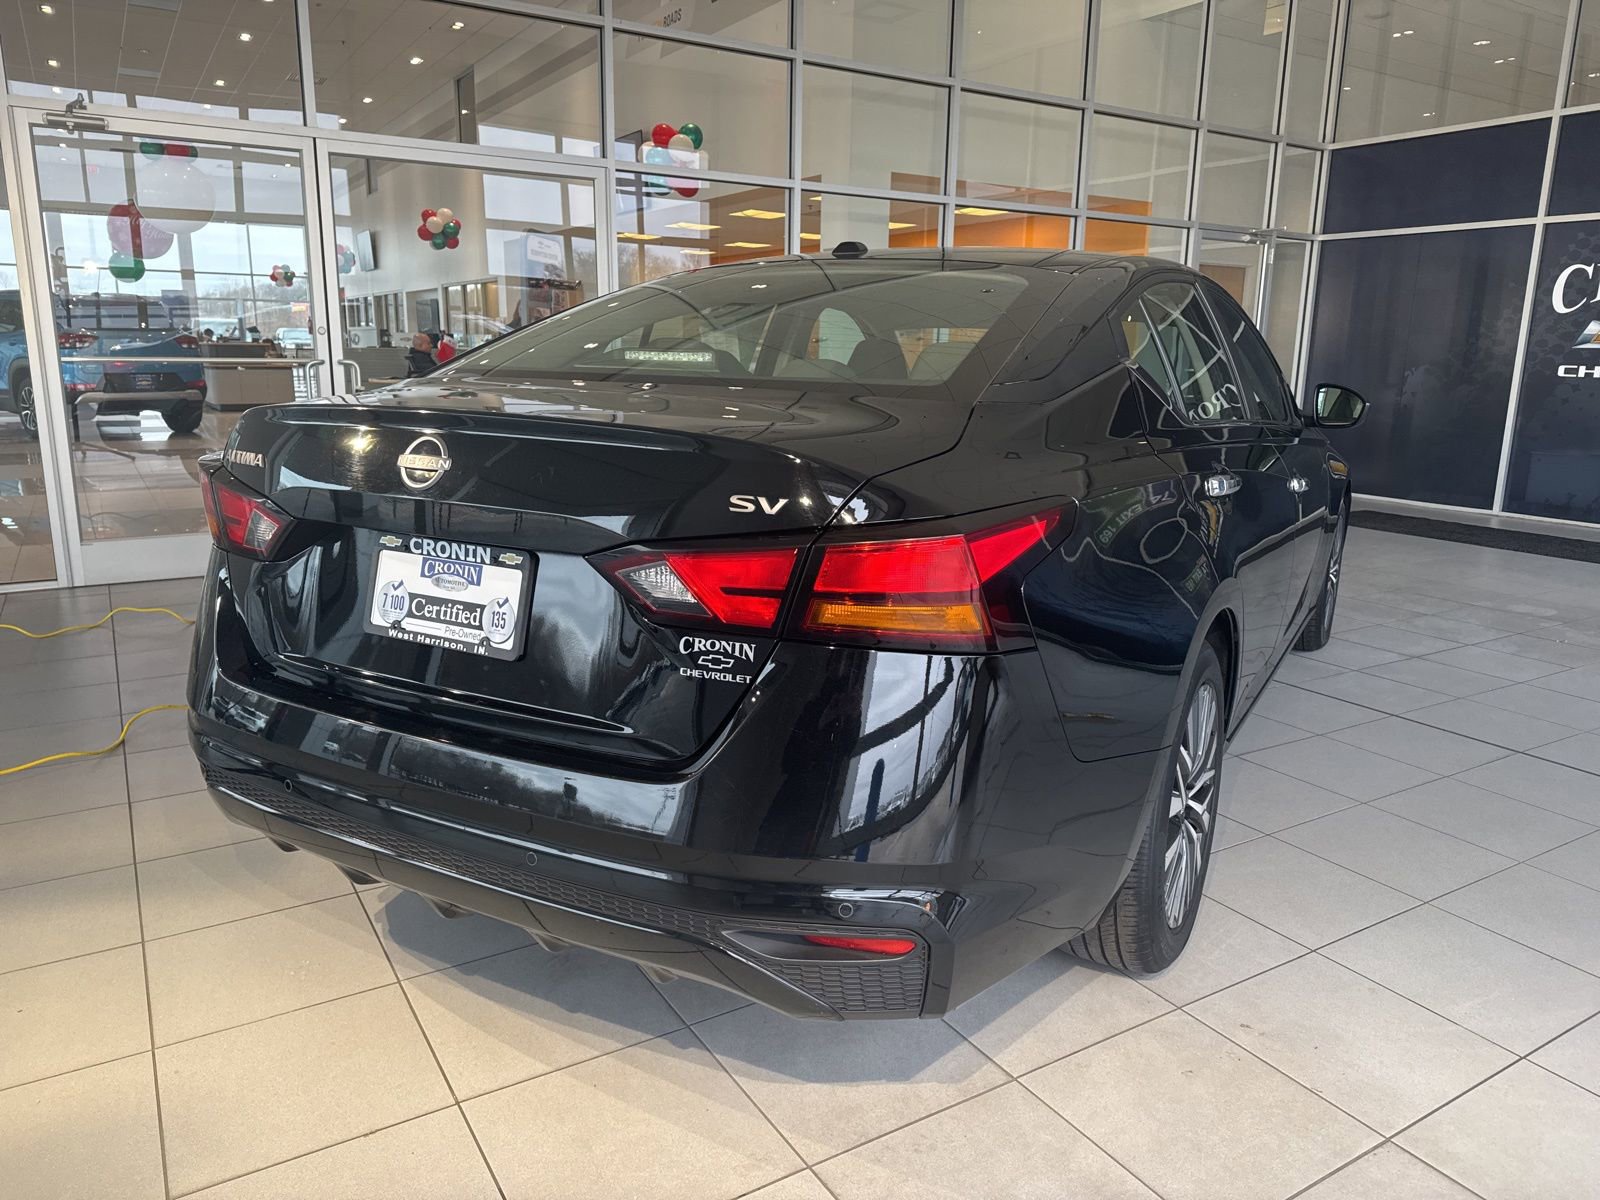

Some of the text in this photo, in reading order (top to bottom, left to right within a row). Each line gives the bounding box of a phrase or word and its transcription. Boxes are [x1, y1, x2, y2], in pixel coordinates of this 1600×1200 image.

[663, 8, 682, 28] ROADS
[399, 455, 450, 469] NISSAN
[728, 494, 789, 515] SV
[409, 537, 492, 564] CRONIN
[424, 560, 480, 585] CRONIN
[391, 595, 405, 611] 100
[411, 598, 481, 626] Certified
[491, 610, 507, 630] 135
[388, 628, 489, 656] West Harrison, IN.
[444, 626, 482, 641] Pre-Owned
[679, 636, 756, 663] CRONIN
[680, 667, 752, 684] CHEVROLET
